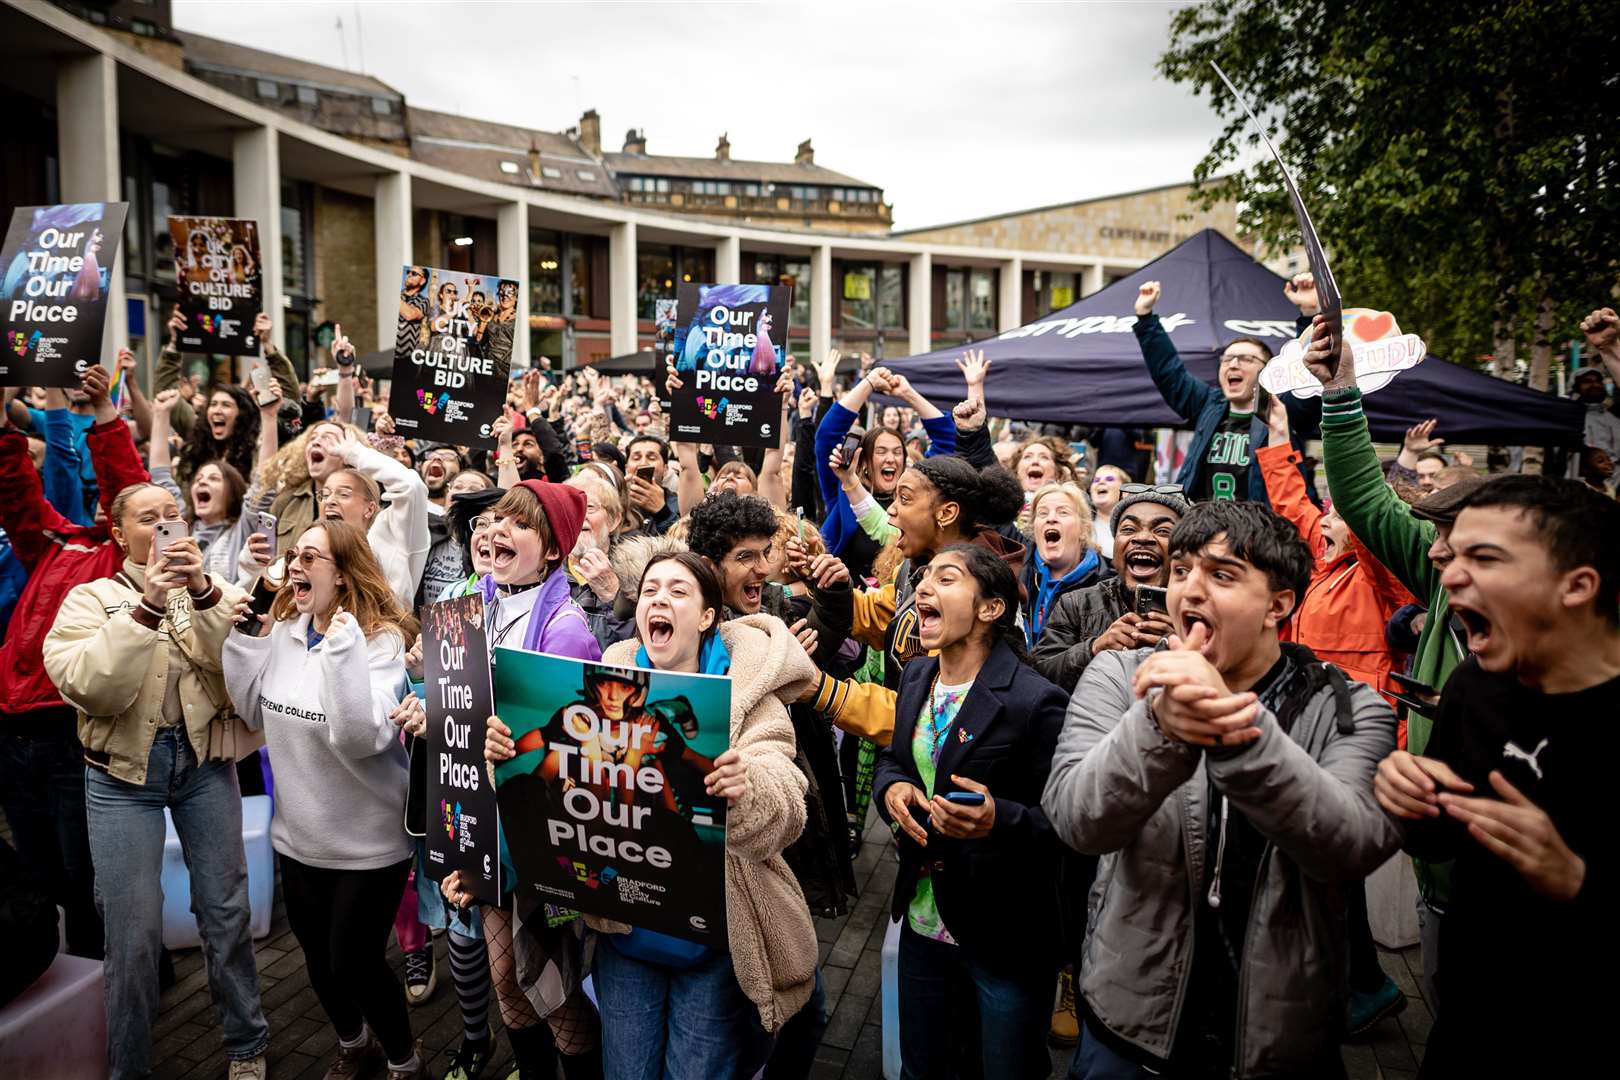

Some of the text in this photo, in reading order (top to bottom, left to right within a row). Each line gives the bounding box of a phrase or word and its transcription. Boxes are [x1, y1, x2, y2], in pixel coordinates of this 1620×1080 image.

[39, 228, 84, 249] Our
[207, 240, 228, 254] UK
[28, 250, 84, 273] Time
[202, 255, 234, 268] CITY
[209, 269, 229, 282] OF
[25, 276, 73, 297] Our
[190, 282, 251, 298] CULTURE
[9, 301, 78, 323] Place
[209, 297, 232, 310] BID
[446, 300, 470, 318] UK
[710, 305, 753, 326] Our
[435, 317, 478, 337] CITY
[702, 326, 757, 348] Time
[441, 335, 467, 354] OF
[411, 349, 493, 375] CULTURE
[706, 349, 750, 369] Our
[434, 370, 465, 388] BID
[696, 370, 758, 392] Place
[440, 640, 465, 671] Our
[438, 676, 472, 709] Time
[444, 715, 471, 749] Our
[563, 704, 651, 750] Our
[440, 753, 479, 791] Place
[549, 741, 664, 793] Time
[563, 787, 651, 830] Our
[547, 818, 672, 868] Place
[616, 875, 666, 893] BRADFORD
